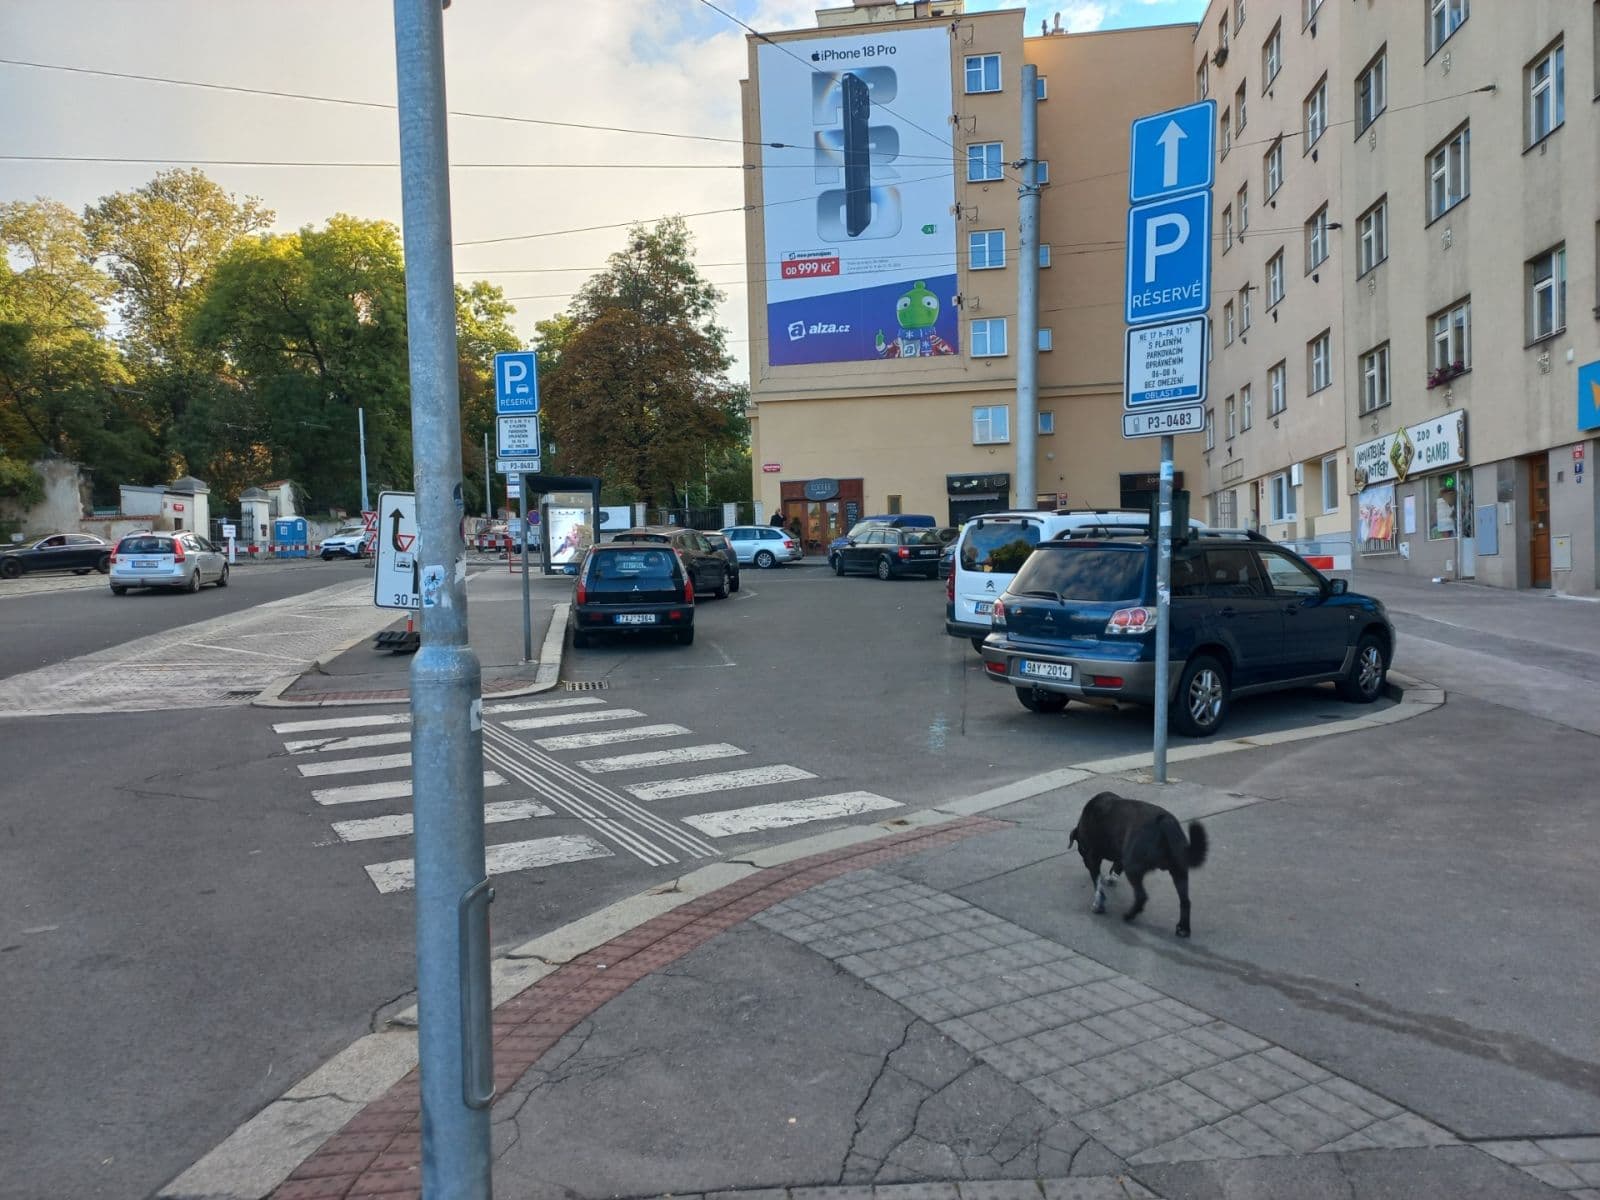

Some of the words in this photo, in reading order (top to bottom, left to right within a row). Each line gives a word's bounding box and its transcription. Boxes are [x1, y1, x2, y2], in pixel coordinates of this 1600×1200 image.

[821, 49, 860, 61] iPhone
[862, 46, 875, 57] 18
[877, 45, 897, 56] Pro
[1144, 213, 1190, 284] P
[785, 267, 797, 275] OD
[798, 262, 818, 274] 999
[1132, 280, 1201, 309] RÉSERVÉ
[808, 322, 851, 335] alza.cz
[1155, 336, 1182, 348] PLATNÝM
[504, 361, 527, 394] P
[1145, 389, 1174, 400] OBLAST
[1148, 413, 1191, 429] P3-0483
[1417, 429, 1431, 442] ZOO
[1426, 442, 1450, 463] GAMBI
[394, 593, 408, 606] 30
[1047, 664, 1068, 676] 2014
